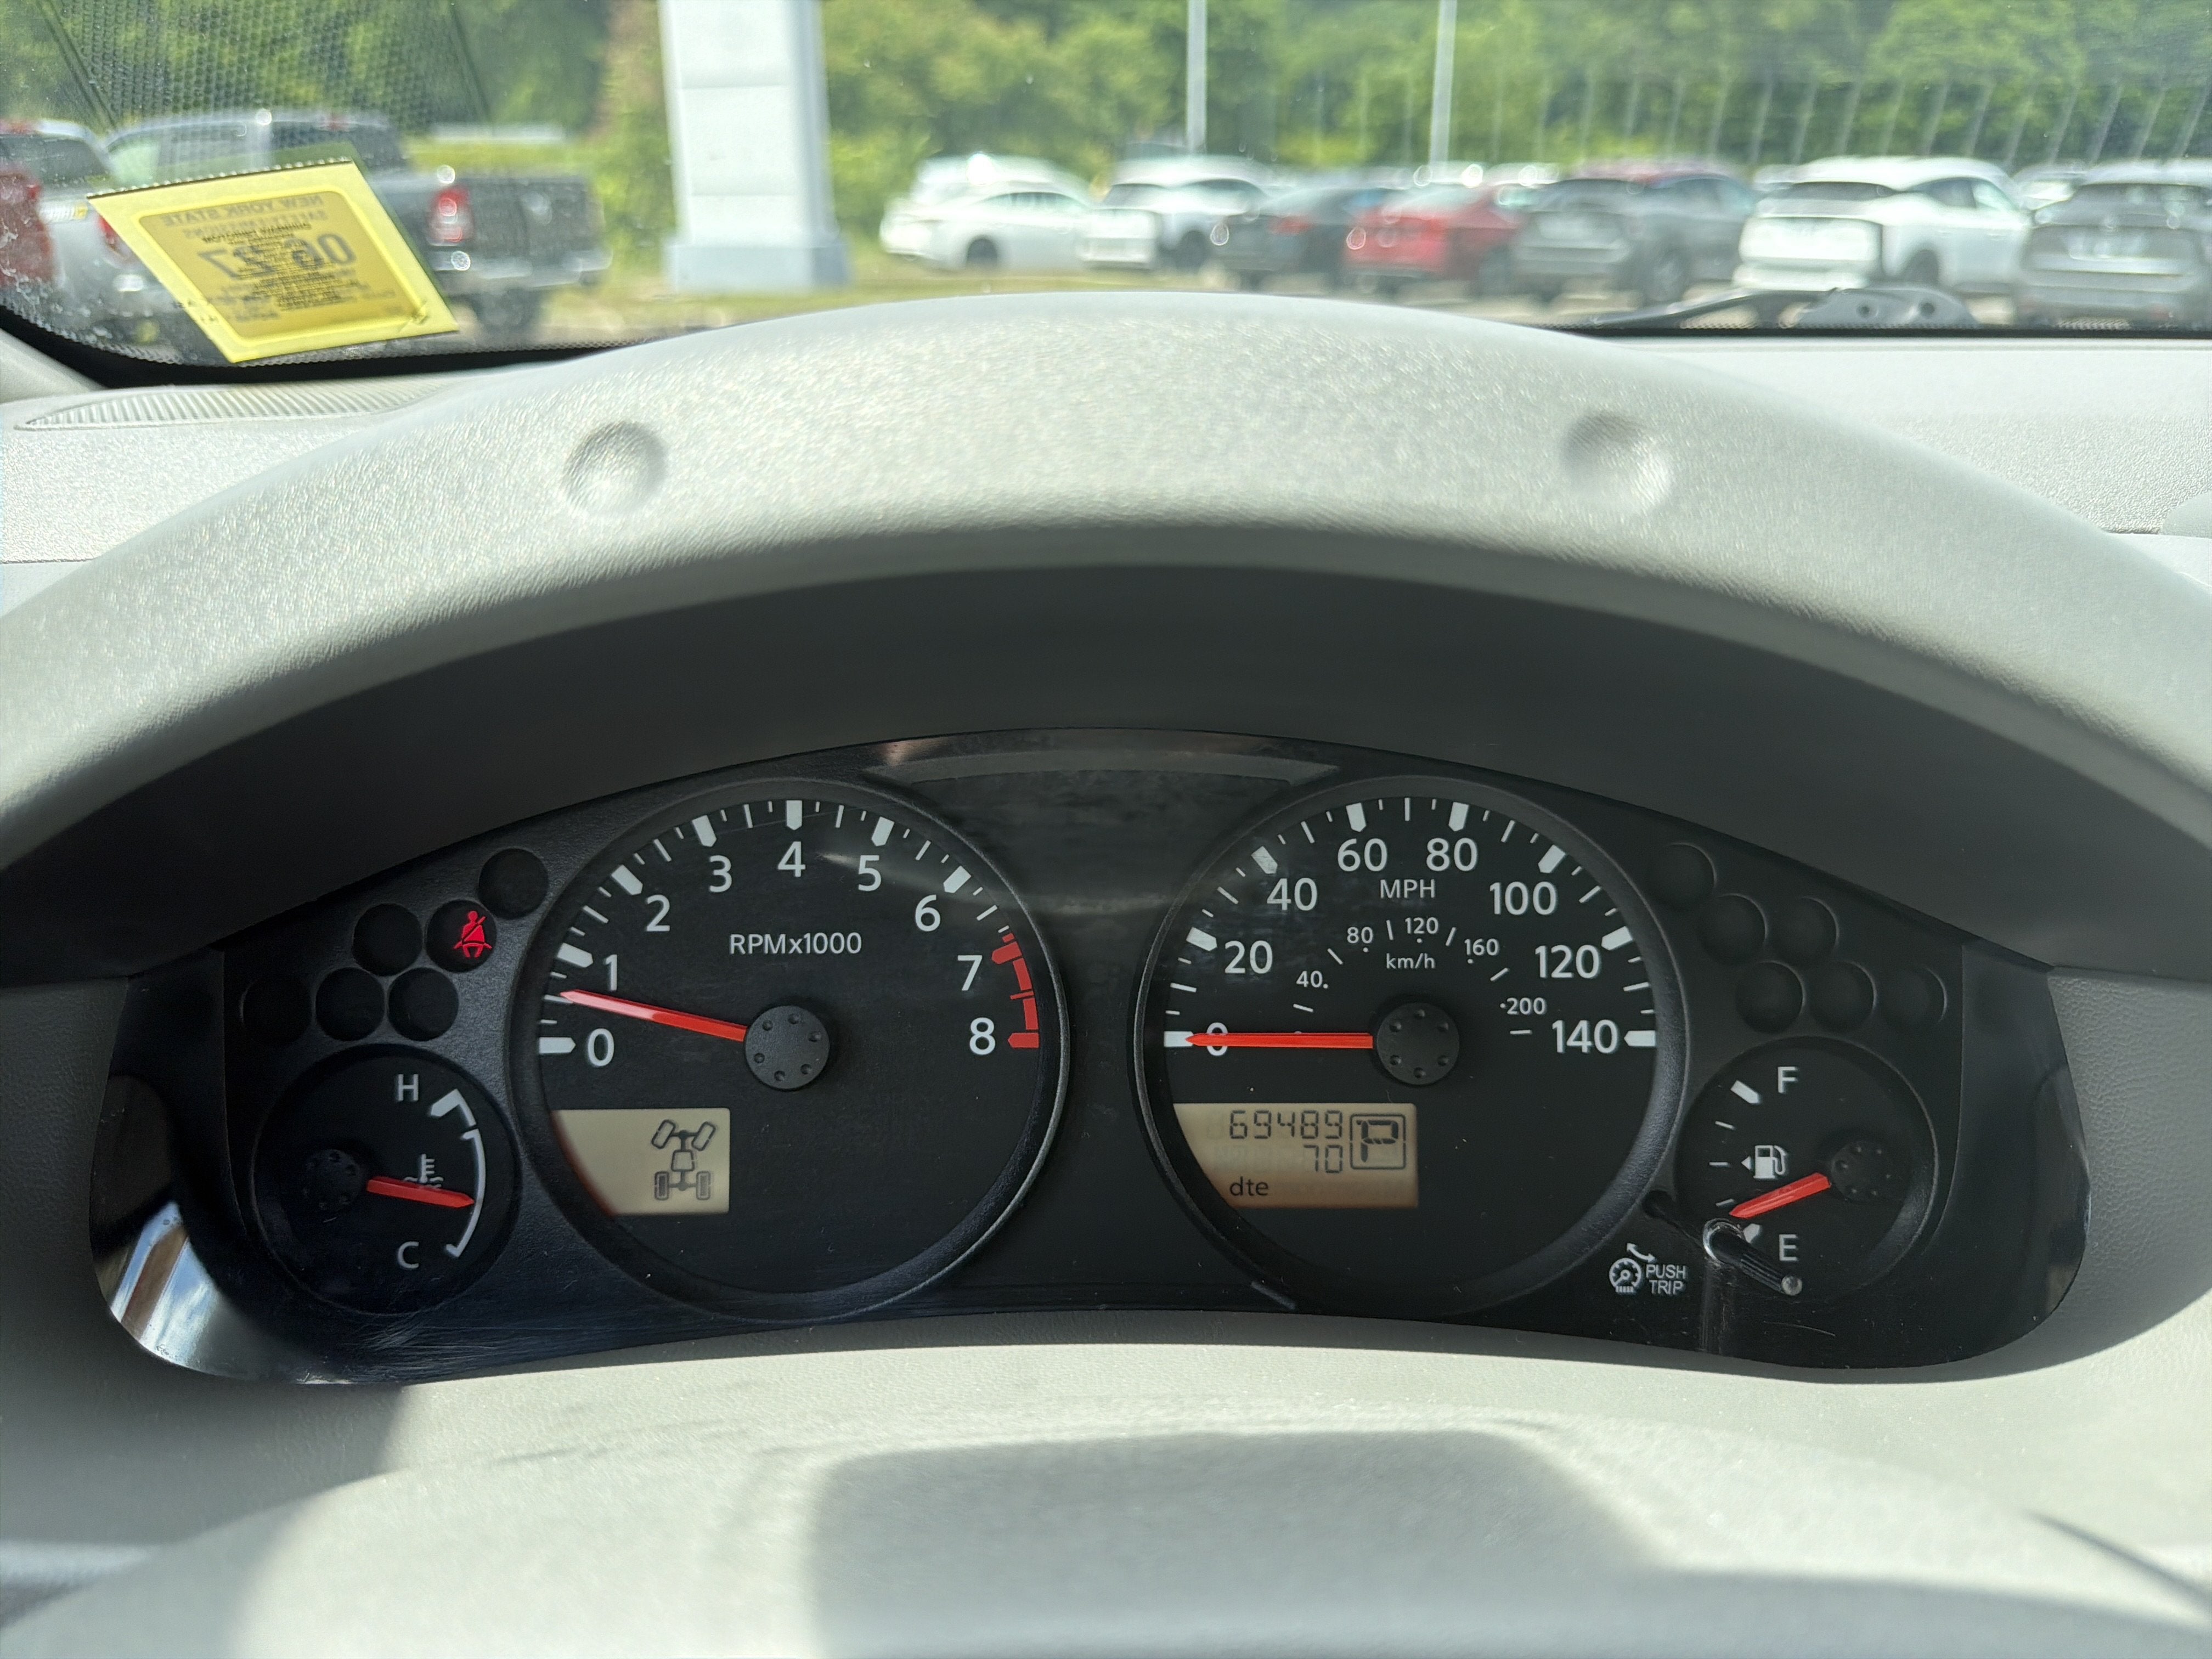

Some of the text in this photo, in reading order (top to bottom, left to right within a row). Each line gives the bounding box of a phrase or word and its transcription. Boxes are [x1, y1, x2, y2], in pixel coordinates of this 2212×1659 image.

[777, 841, 806, 878] 4
[1337, 838, 1389, 872] 60
[1426, 838, 1479, 872] 80
[709, 855, 733, 893] 3
[858, 855, 882, 892] 5
[1380, 879, 1436, 899] MPH
[1266, 877, 1318, 911] 40
[1489, 881, 1558, 916] 100
[646, 894, 671, 932] 2
[915, 894, 941, 932] 6
[1404, 917, 1440, 935] 120
[730, 932, 863, 955] RPMx1000
[1346, 926, 1374, 945] 80
[1464, 938, 1500, 957] 160
[605, 953, 618, 991] 1
[957, 955, 984, 991] 7
[1224, 940, 1274, 975] 20
[1386, 952, 1436, 970] km/h
[1534, 944, 1601, 979] 120
[1295, 970, 1323, 989] 40
[1506, 997, 1548, 1016] 200
[587, 1028, 616, 1067] 0
[969, 1017, 997, 1056] 8
[1551, 1019, 1621, 1054] 140
[397, 1073, 420, 1102] H
[1777, 1065, 1799, 1094] F
[1229, 1109, 1400, 1163] 69489 P
[1302, 1144, 1343, 1173] 70
[1229, 1176, 1269, 1197] dte
[397, 1240, 420, 1270] C
[1778, 1233, 1799, 1262] E
[1645, 1263, 1688, 1280] PUSH
[1648, 1279, 1686, 1296] TRIP
